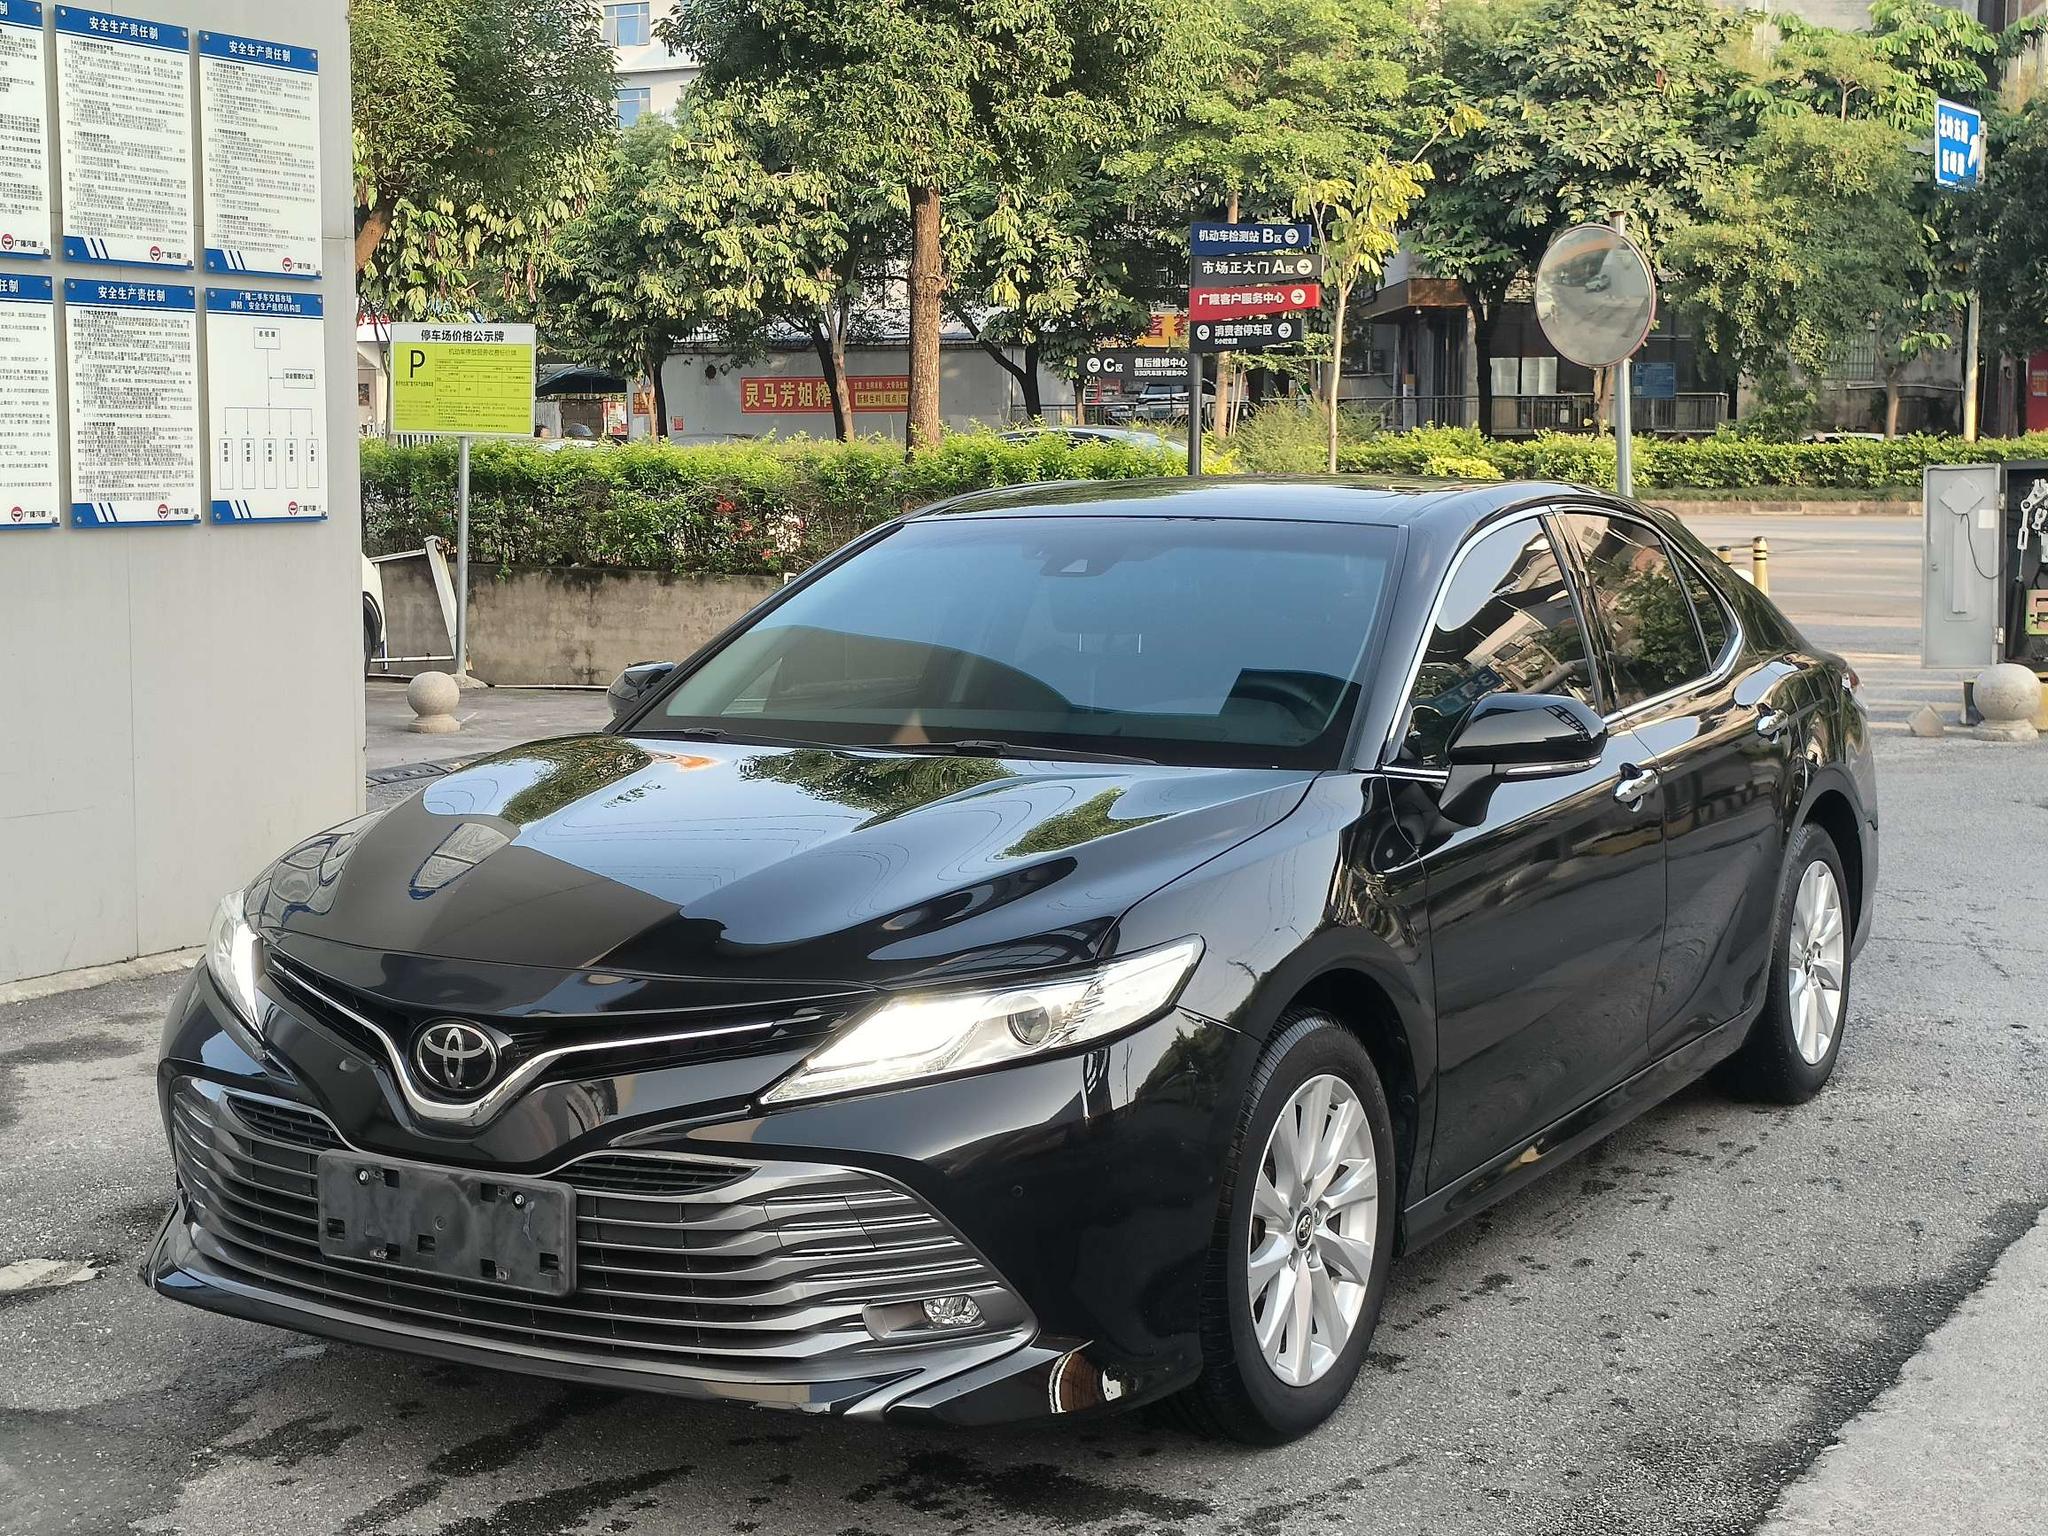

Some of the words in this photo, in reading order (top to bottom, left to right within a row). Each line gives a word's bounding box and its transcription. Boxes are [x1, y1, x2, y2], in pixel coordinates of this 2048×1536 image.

[89, 16, 159, 40] 安全生产责任制
[229, 40, 291, 63] 安全生产责任制
[1199, 230, 1260, 243] 机动车检测站
[1262, 228, 1283, 244] B区
[1202, 260, 1270, 275] 市场正大门
[1272, 259, 1294, 274] A区
[98, 285, 166, 302] 安全生产责任制
[239, 291, 292, 303] 广隆二手车交易市场
[1198, 292, 1285, 305] 广隆客户服务中心
[421, 329, 505, 342] 停车场价格公示牌
[1214, 323, 1273, 337] 消费者停车区
[409, 349, 426, 379] P
[1103, 358, 1123, 373] C区
[1134, 357, 1188, 368] 售后维修中心
